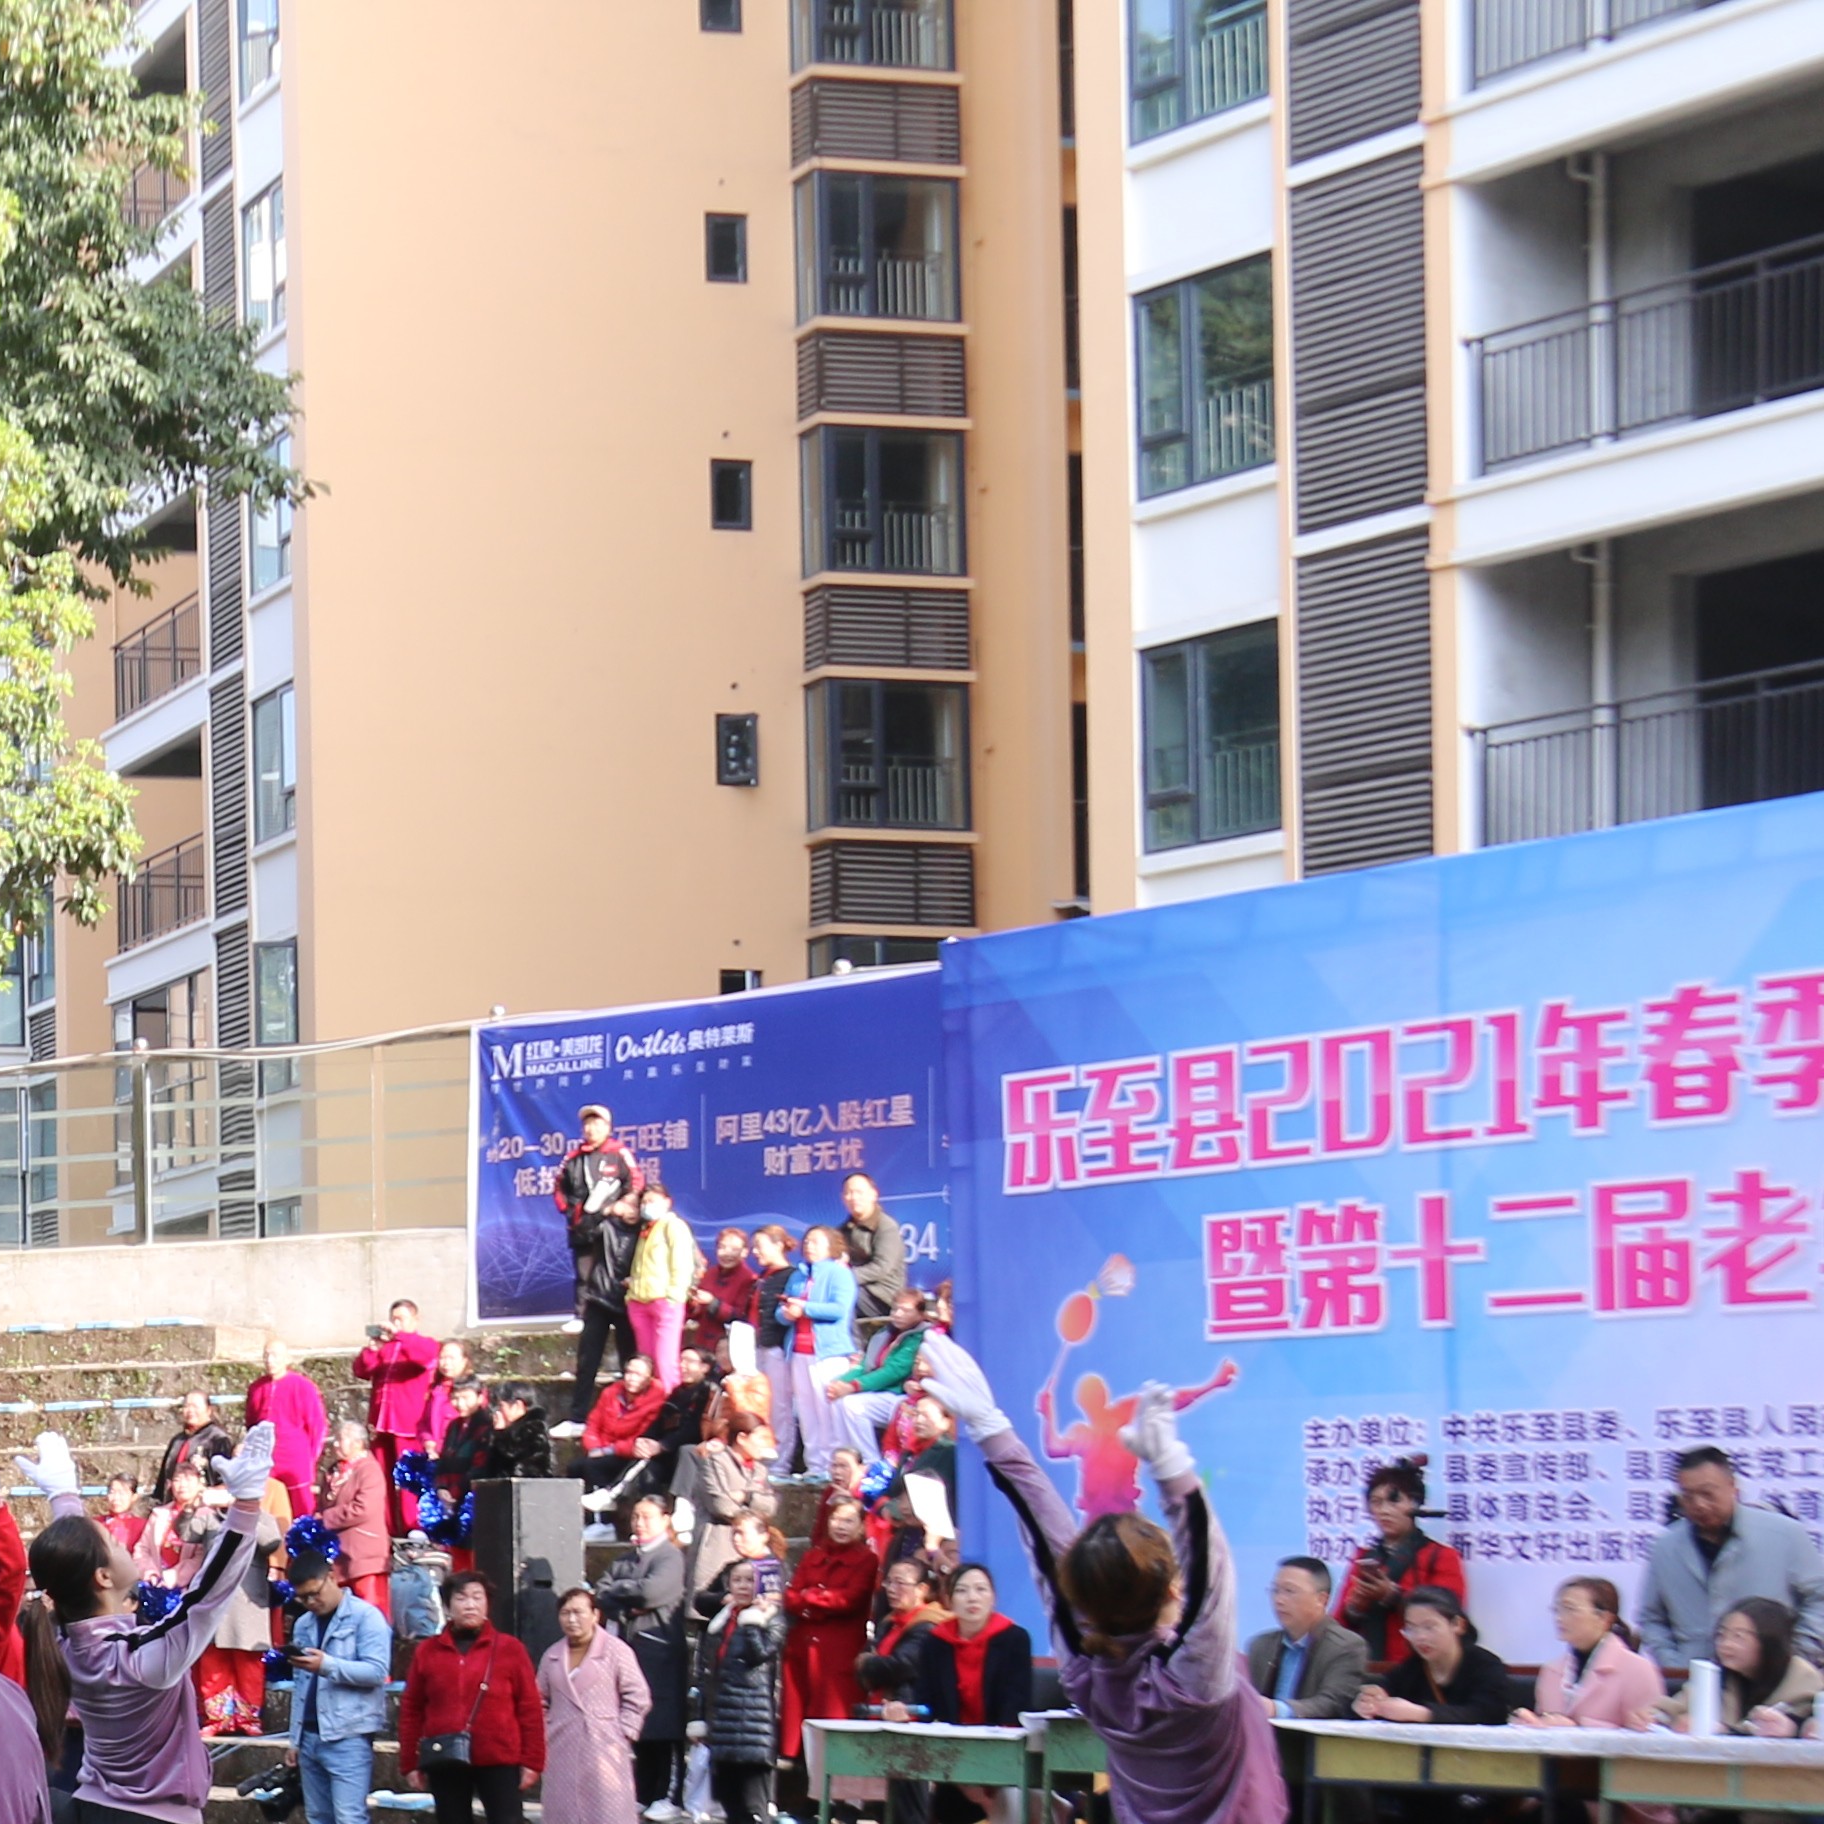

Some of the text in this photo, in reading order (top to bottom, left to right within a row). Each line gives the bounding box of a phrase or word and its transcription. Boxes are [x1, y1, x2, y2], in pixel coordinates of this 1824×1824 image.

[615, 1022, 755, 1063] Outlets 奥特莱斯
[526, 1057, 604, 1077] MACALLINE
[1002, 970, 1824, 1195] 乐至县2021年春季
[715, 1094, 916, 1145] 阿里43亿入股红星
[763, 1138, 866, 1177] 财富无忧
[1204, 1165, 1824, 1341] 暨第十二届老
[1440, 1403, 1824, 1444] 中共乐至县委、乐至县人民
[1444, 1446, 1824, 1484] 县委宣传部、县直关党工
